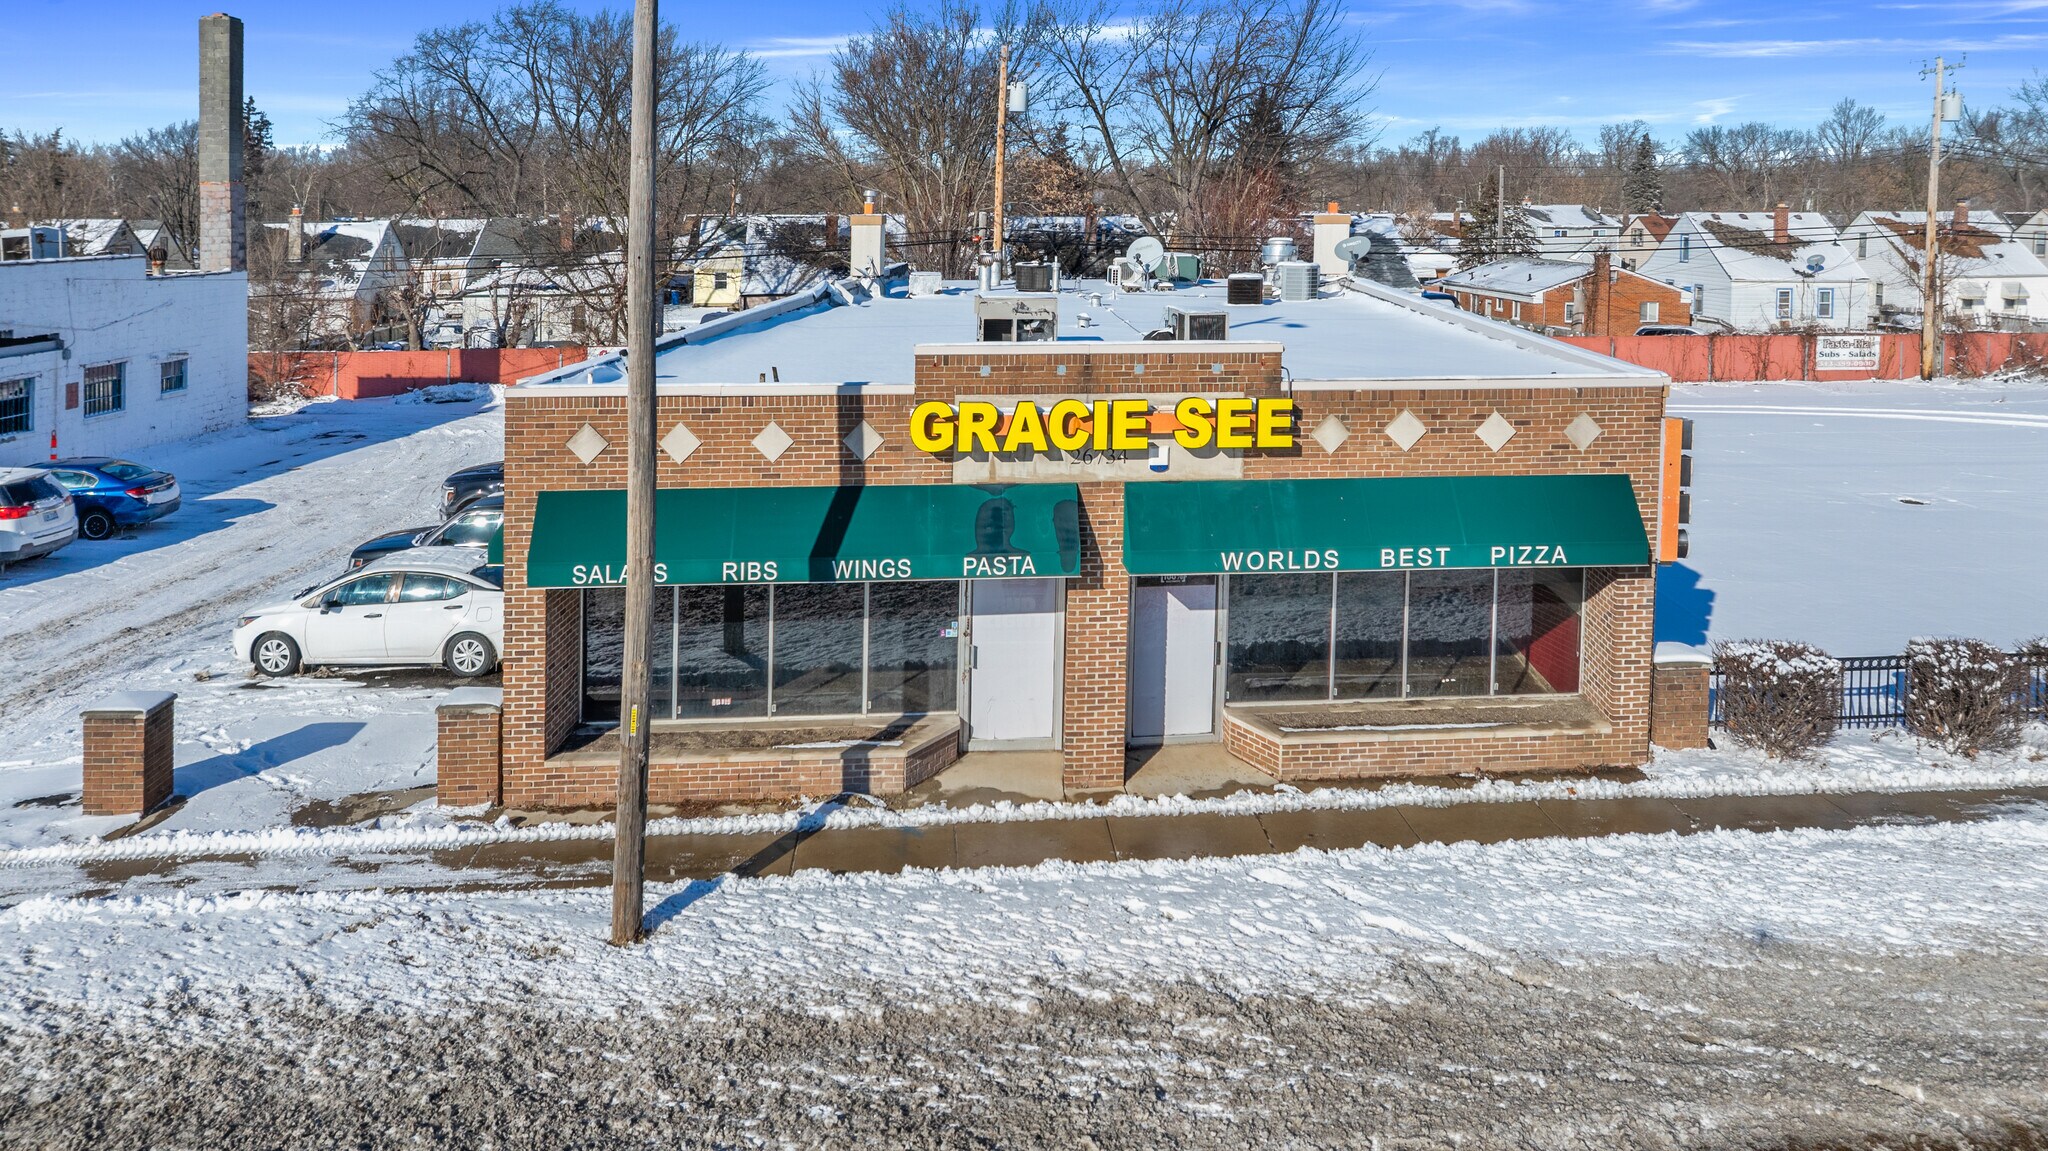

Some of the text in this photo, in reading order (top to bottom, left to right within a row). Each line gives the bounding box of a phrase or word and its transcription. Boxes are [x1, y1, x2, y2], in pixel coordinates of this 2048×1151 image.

[1848, 350, 1876, 358] Salads
[910, 397, 1293, 452] GRACIE SEE
[572, 555, 1036, 584] SALAS RIBS WINGS PASTA
[1220, 546, 1567, 571] WORLDS BEST PIZZA
